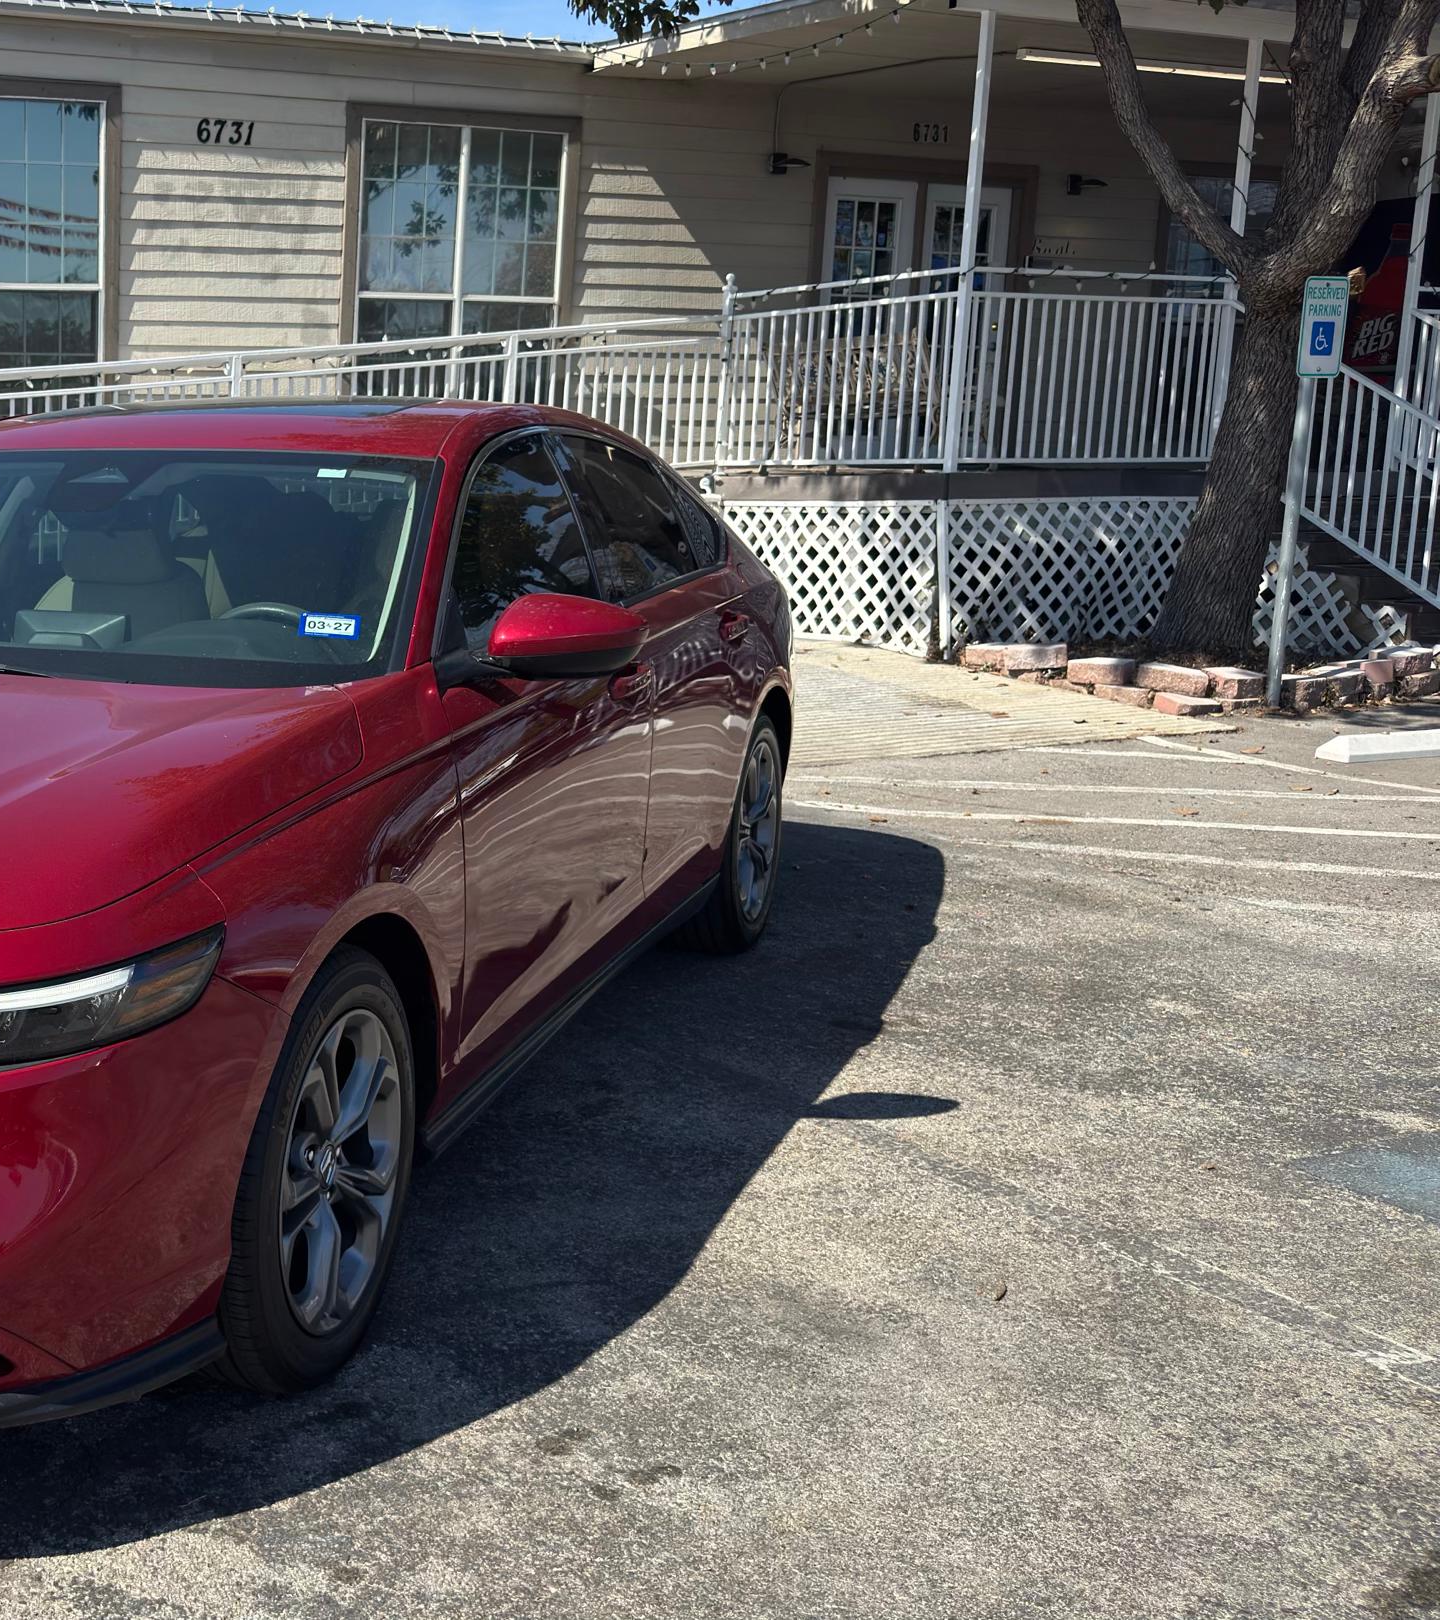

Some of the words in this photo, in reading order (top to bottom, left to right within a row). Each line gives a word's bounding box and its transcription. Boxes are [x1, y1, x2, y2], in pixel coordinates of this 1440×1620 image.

[196, 118, 255, 146] 6731
[913, 123, 948, 143] 6731
[1308, 287, 1346, 300] RESERVED
[1308, 304, 1342, 317] PARKING
[1358, 313, 1397, 339] BIG
[1352, 330, 1395, 359] RED
[308, 620, 326, 630] 03
[333, 622, 352, 632] 27
